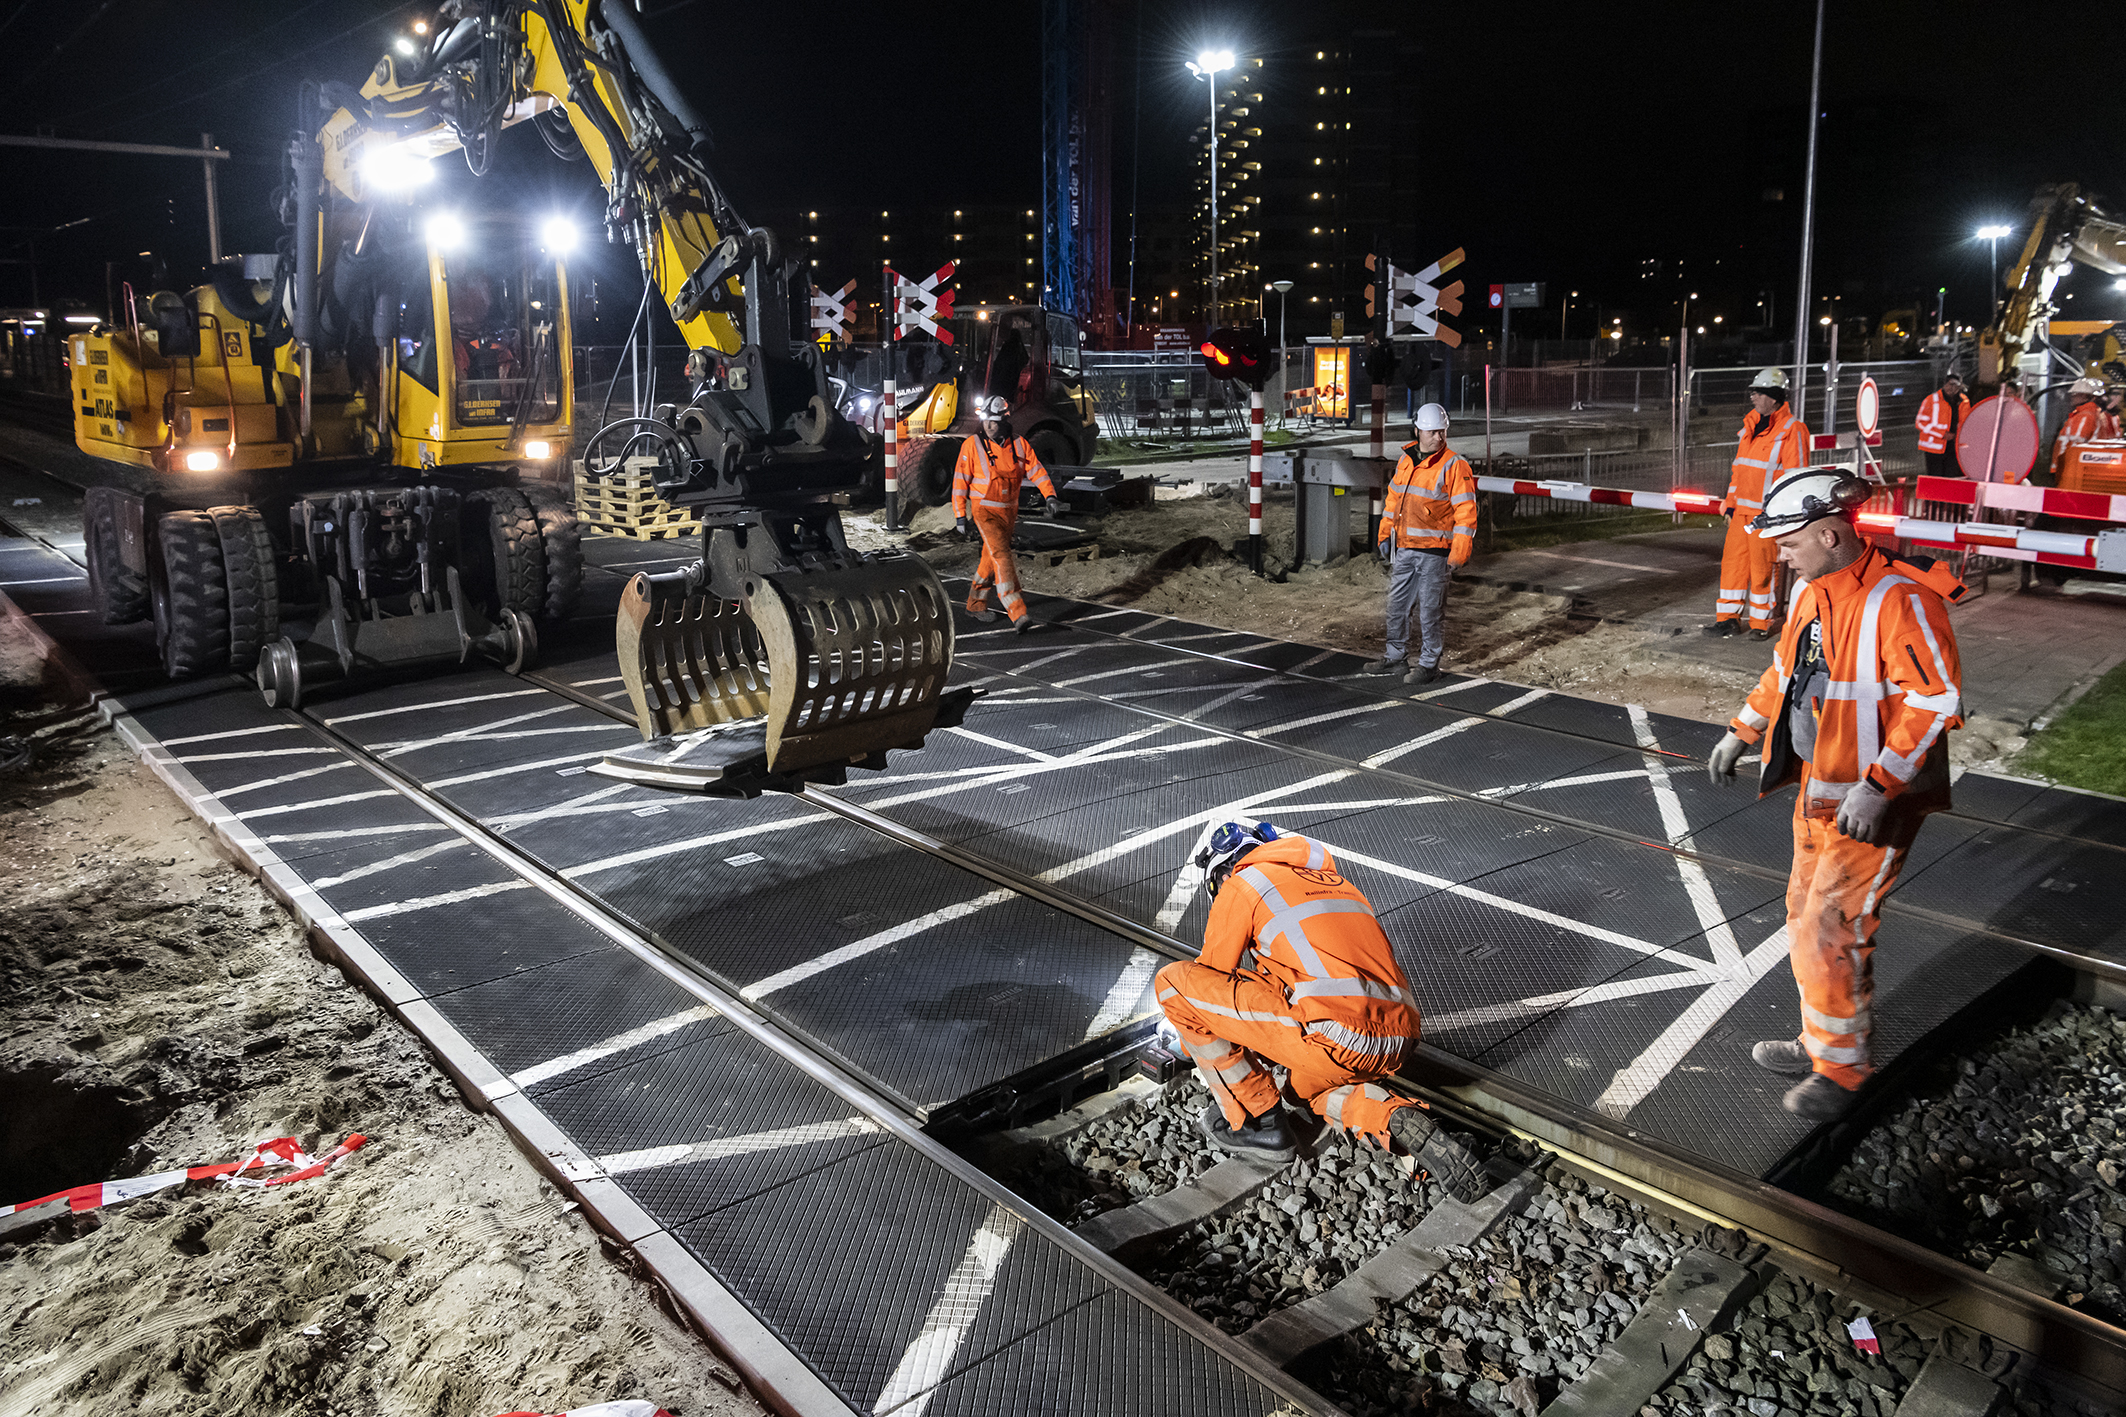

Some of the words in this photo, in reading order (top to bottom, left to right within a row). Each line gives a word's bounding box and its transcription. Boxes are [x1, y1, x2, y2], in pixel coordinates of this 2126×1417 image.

[1068, 138, 1080, 167] TOL
[1068, 171, 1080, 197] der
[95, 398, 114, 420] ATLAS
